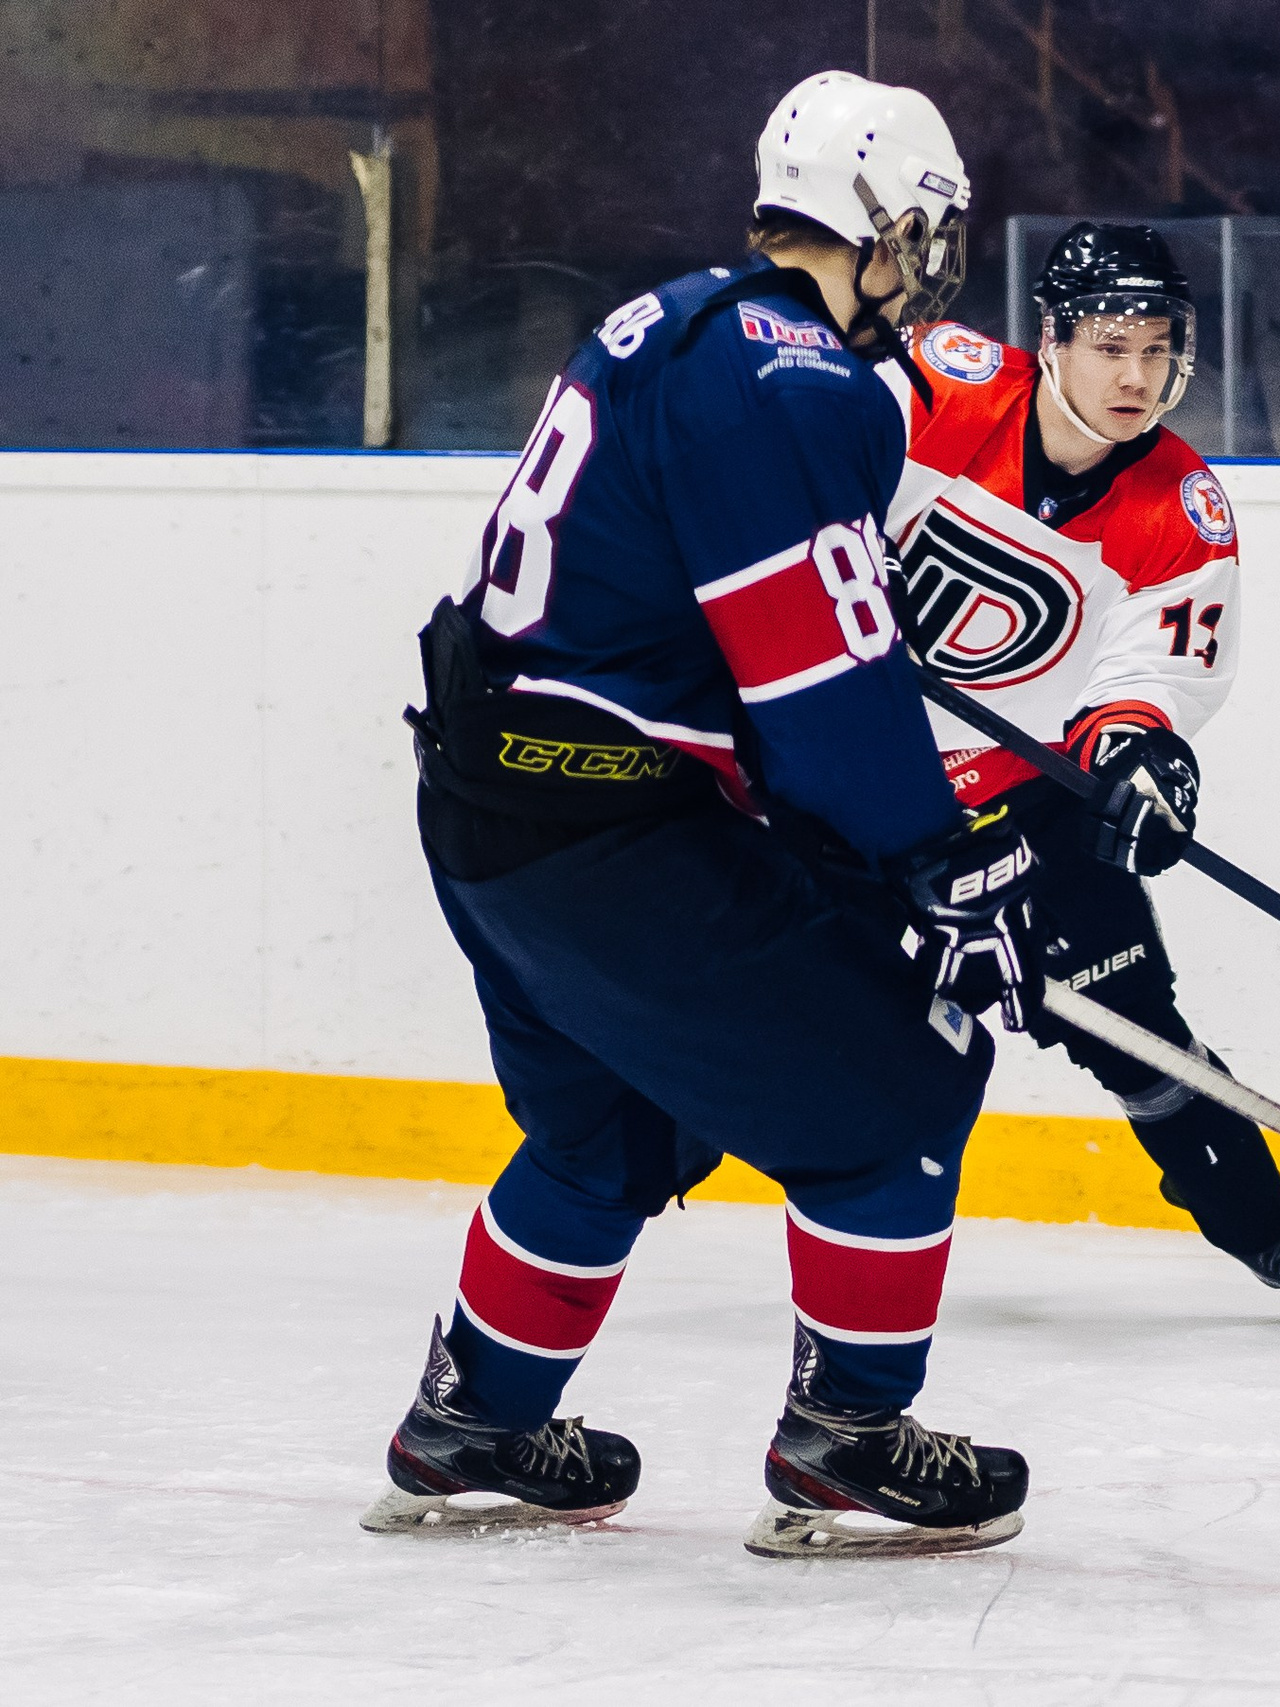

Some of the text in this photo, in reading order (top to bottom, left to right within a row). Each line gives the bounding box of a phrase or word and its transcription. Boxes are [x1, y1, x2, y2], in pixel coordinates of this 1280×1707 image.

[757, 356, 852, 380] UNITED COMPANY
[476, 374, 595, 639] 8
[812, 512, 902, 662] 8
[500, 732, 682, 780] CCM
[950, 834, 1036, 904] BAU
[878, 1486, 921, 1507] BAUER
